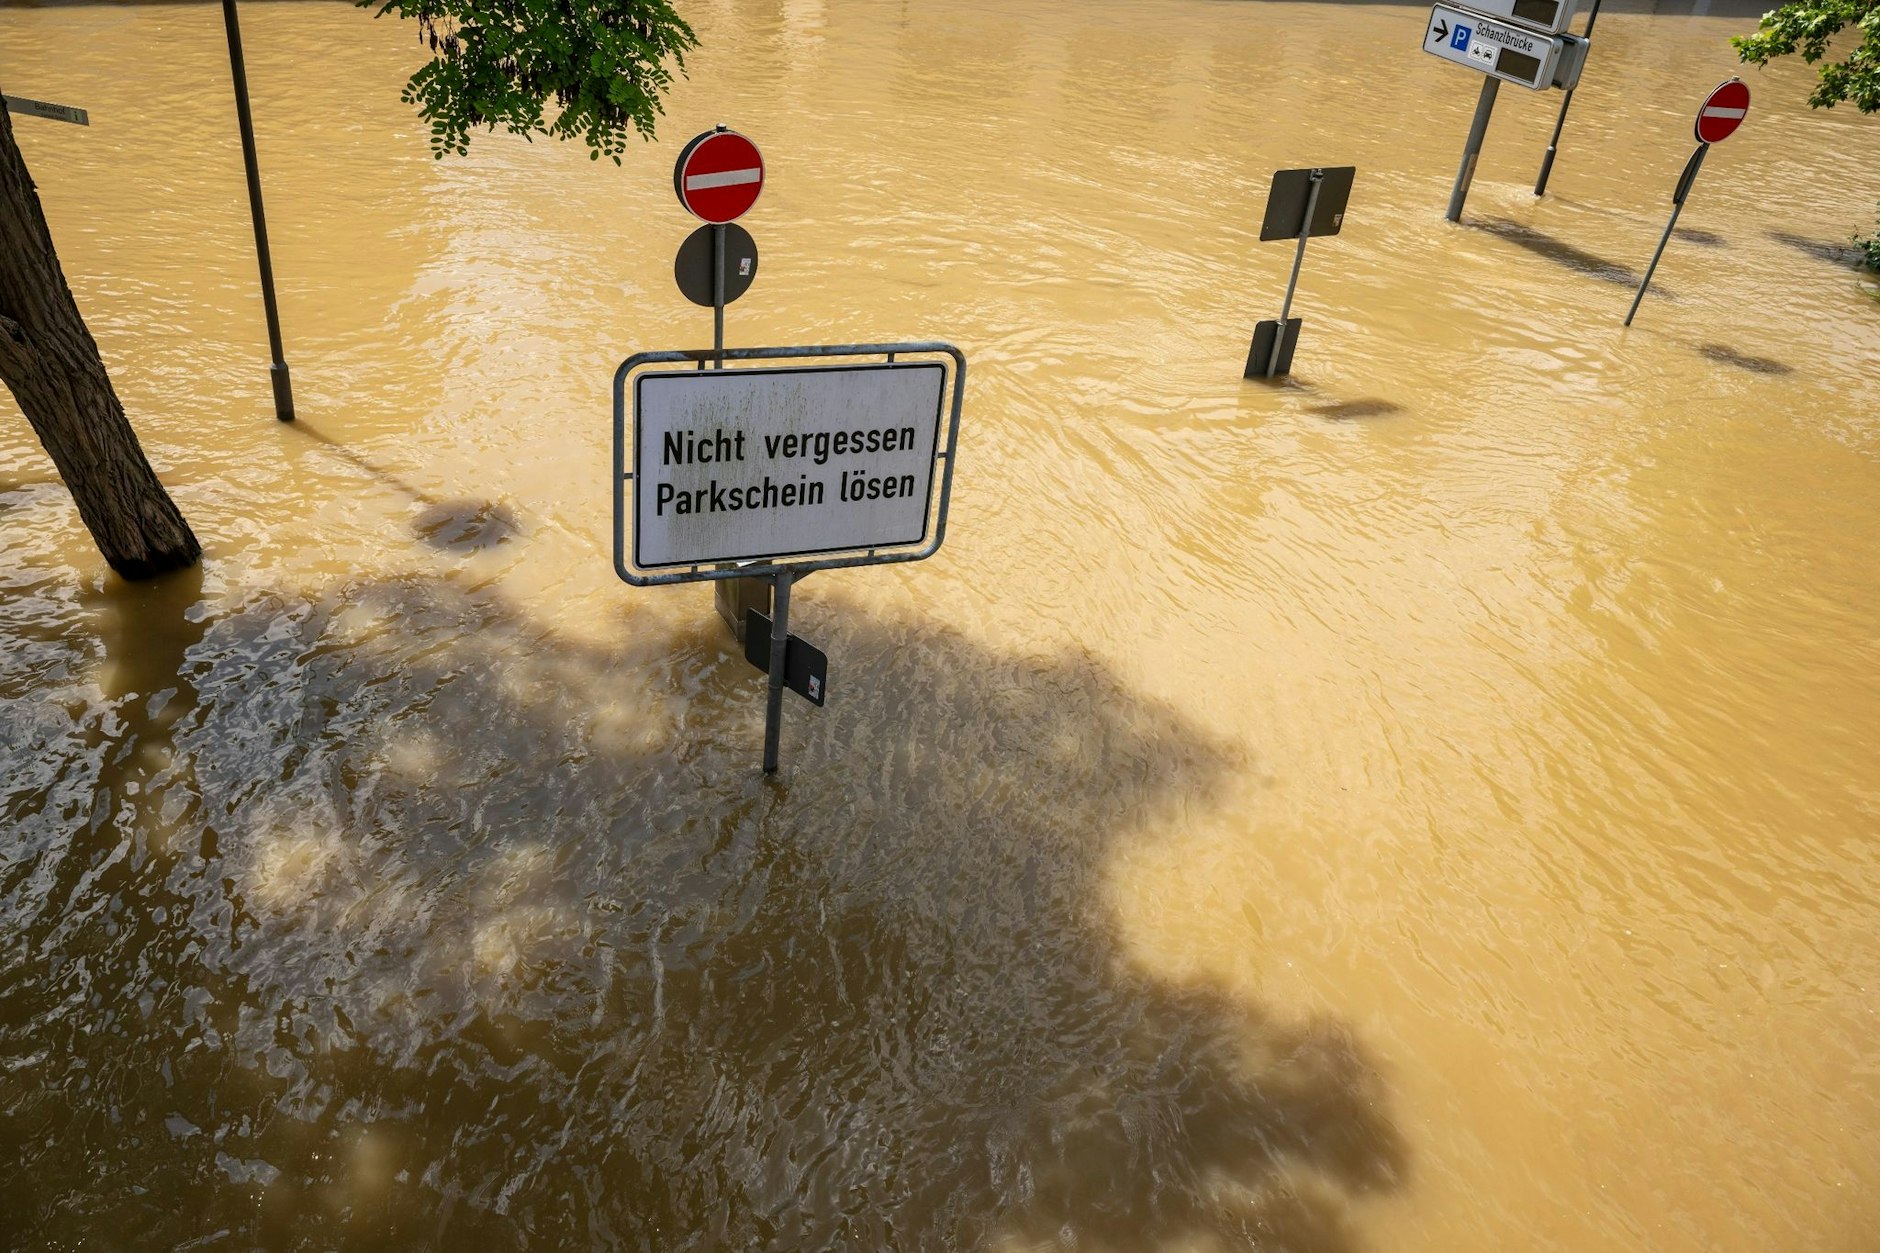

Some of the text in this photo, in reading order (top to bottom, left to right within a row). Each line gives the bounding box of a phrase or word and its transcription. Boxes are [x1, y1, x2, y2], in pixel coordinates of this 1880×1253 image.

[1455, 22, 1534, 52] P Schanzlbrücke
[663, 427, 915, 465] Nicht vergessen
[656, 470, 915, 516] Parkschein lösen
